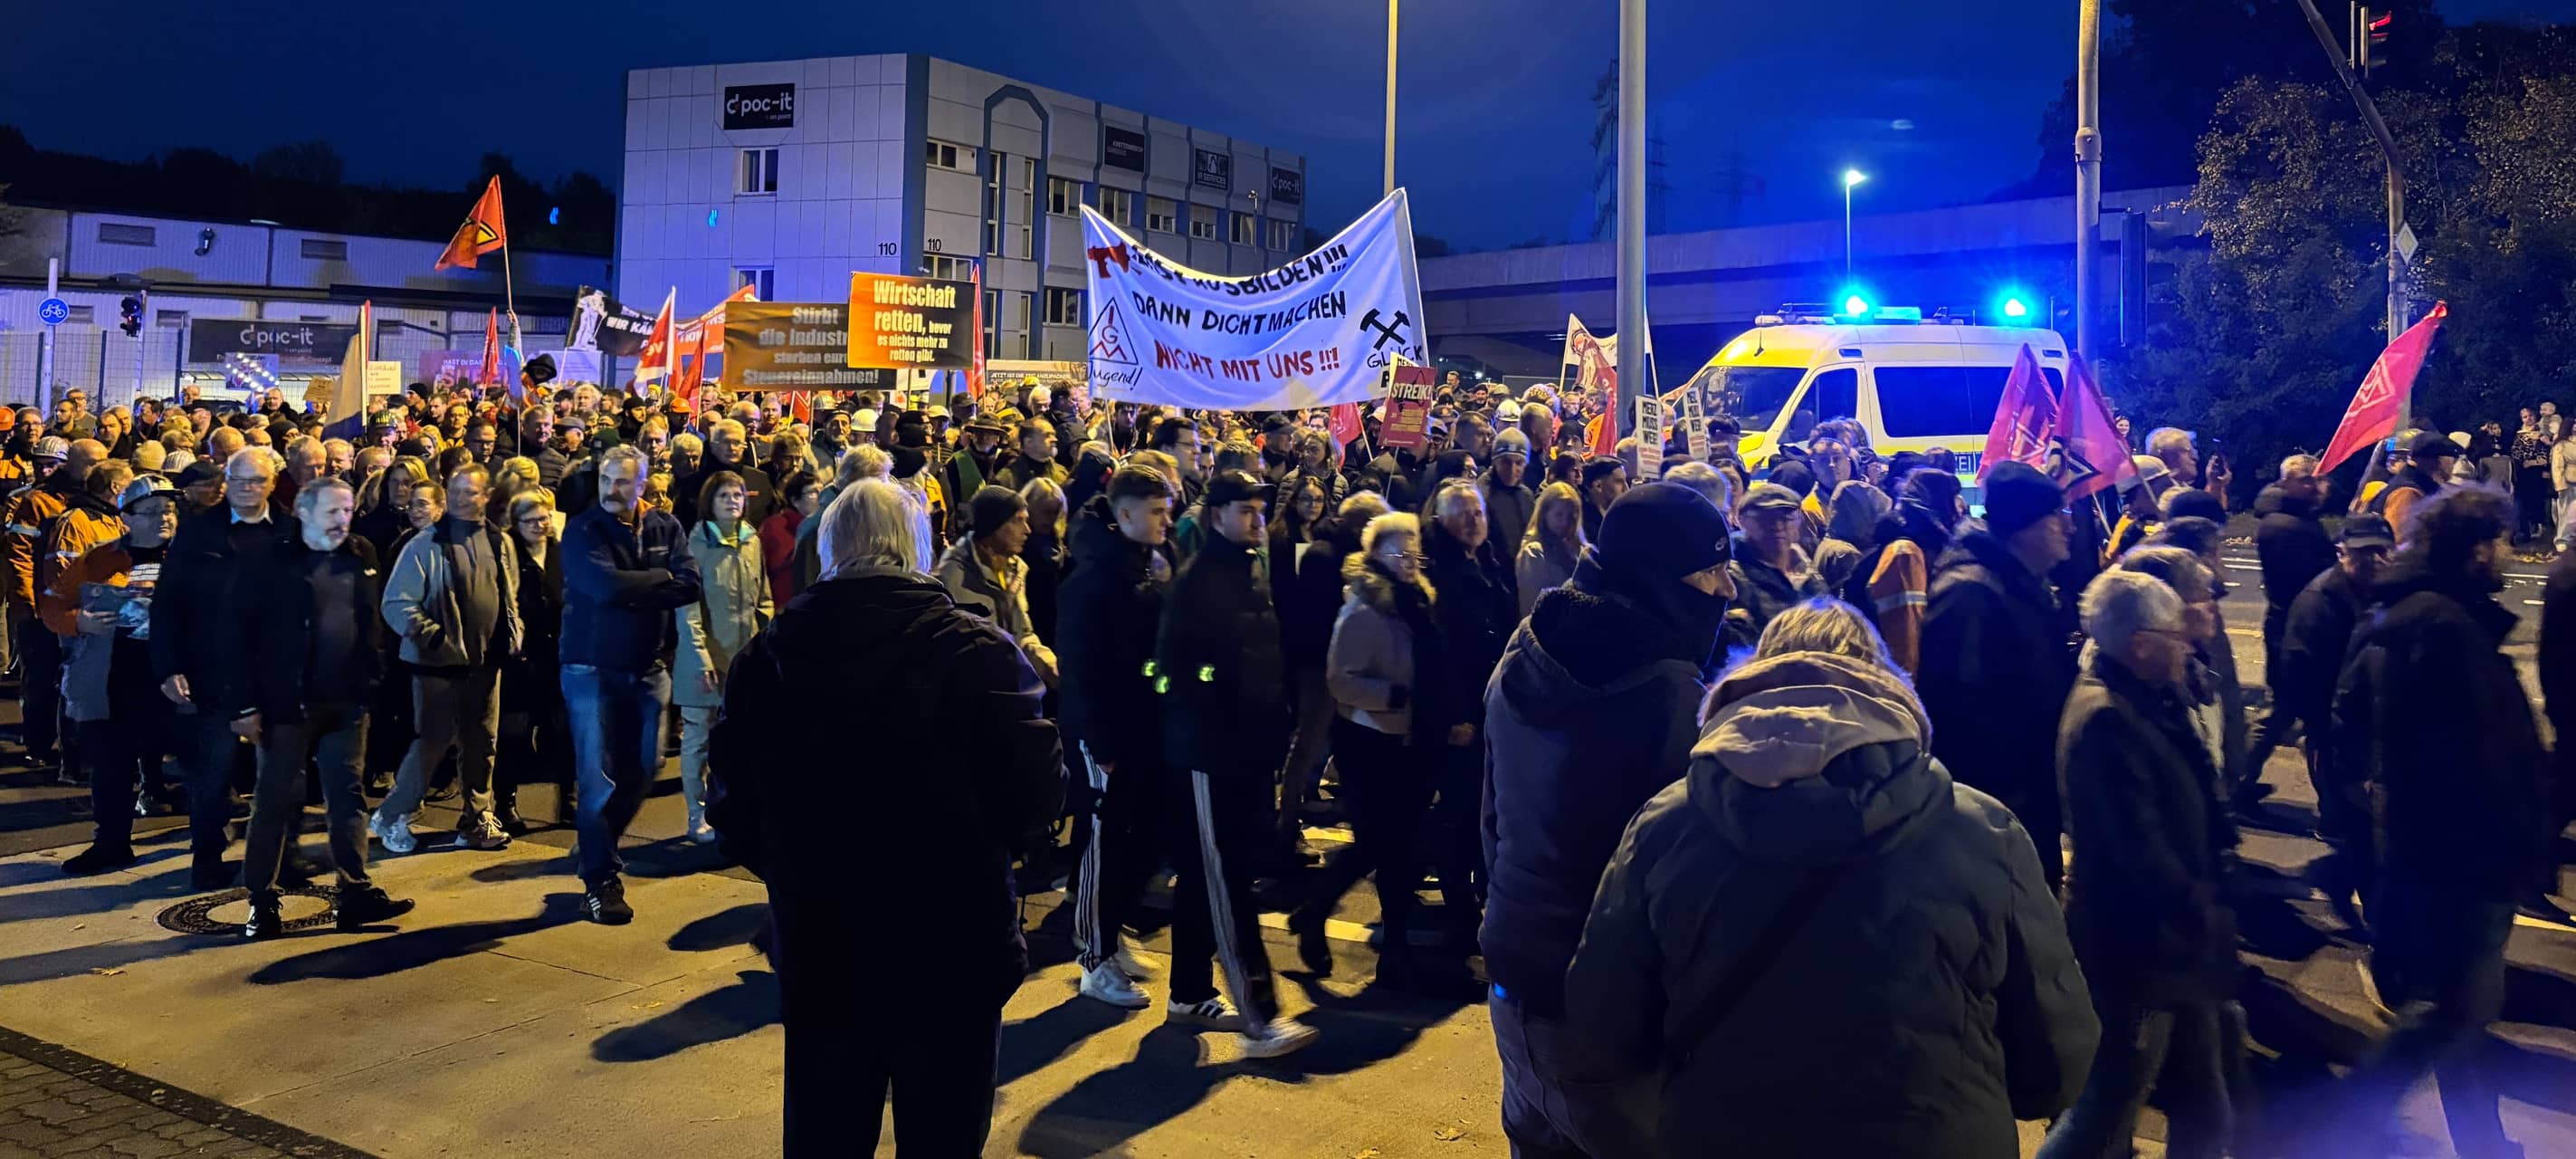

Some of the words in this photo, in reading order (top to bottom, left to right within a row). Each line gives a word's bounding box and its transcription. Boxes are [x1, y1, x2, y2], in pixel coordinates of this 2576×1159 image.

[878, 242, 897, 255] 110
[928, 238, 941, 252] 110
[873, 280, 956, 309] Wirtschaft
[792, 306, 839, 325] Stirbt
[1132, 290, 1191, 329] DANN
[1201, 290, 1347, 335] DICHTMACHEN
[606, 316, 629, 330] WIR
[873, 310, 927, 335] retten,
[758, 329, 786, 346] die
[789, 329, 849, 346] Industr
[877, 335, 888, 346] es
[889, 334, 915, 347] nichts
[916, 336, 938, 349] mehr
[939, 337, 948, 349] zu
[775, 351, 822, 364] sterben
[824, 353, 848, 364] eur
[890, 349, 915, 361] retten
[1154, 340, 1216, 379] NICHT
[1221, 359, 1260, 382] MIT
[1267, 349, 1313, 379] UNS
[743, 369, 879, 385] Steuereinnahmen!
[1088, 359, 1143, 390] Jugend!
[1391, 382, 1433, 400] STREIK!
